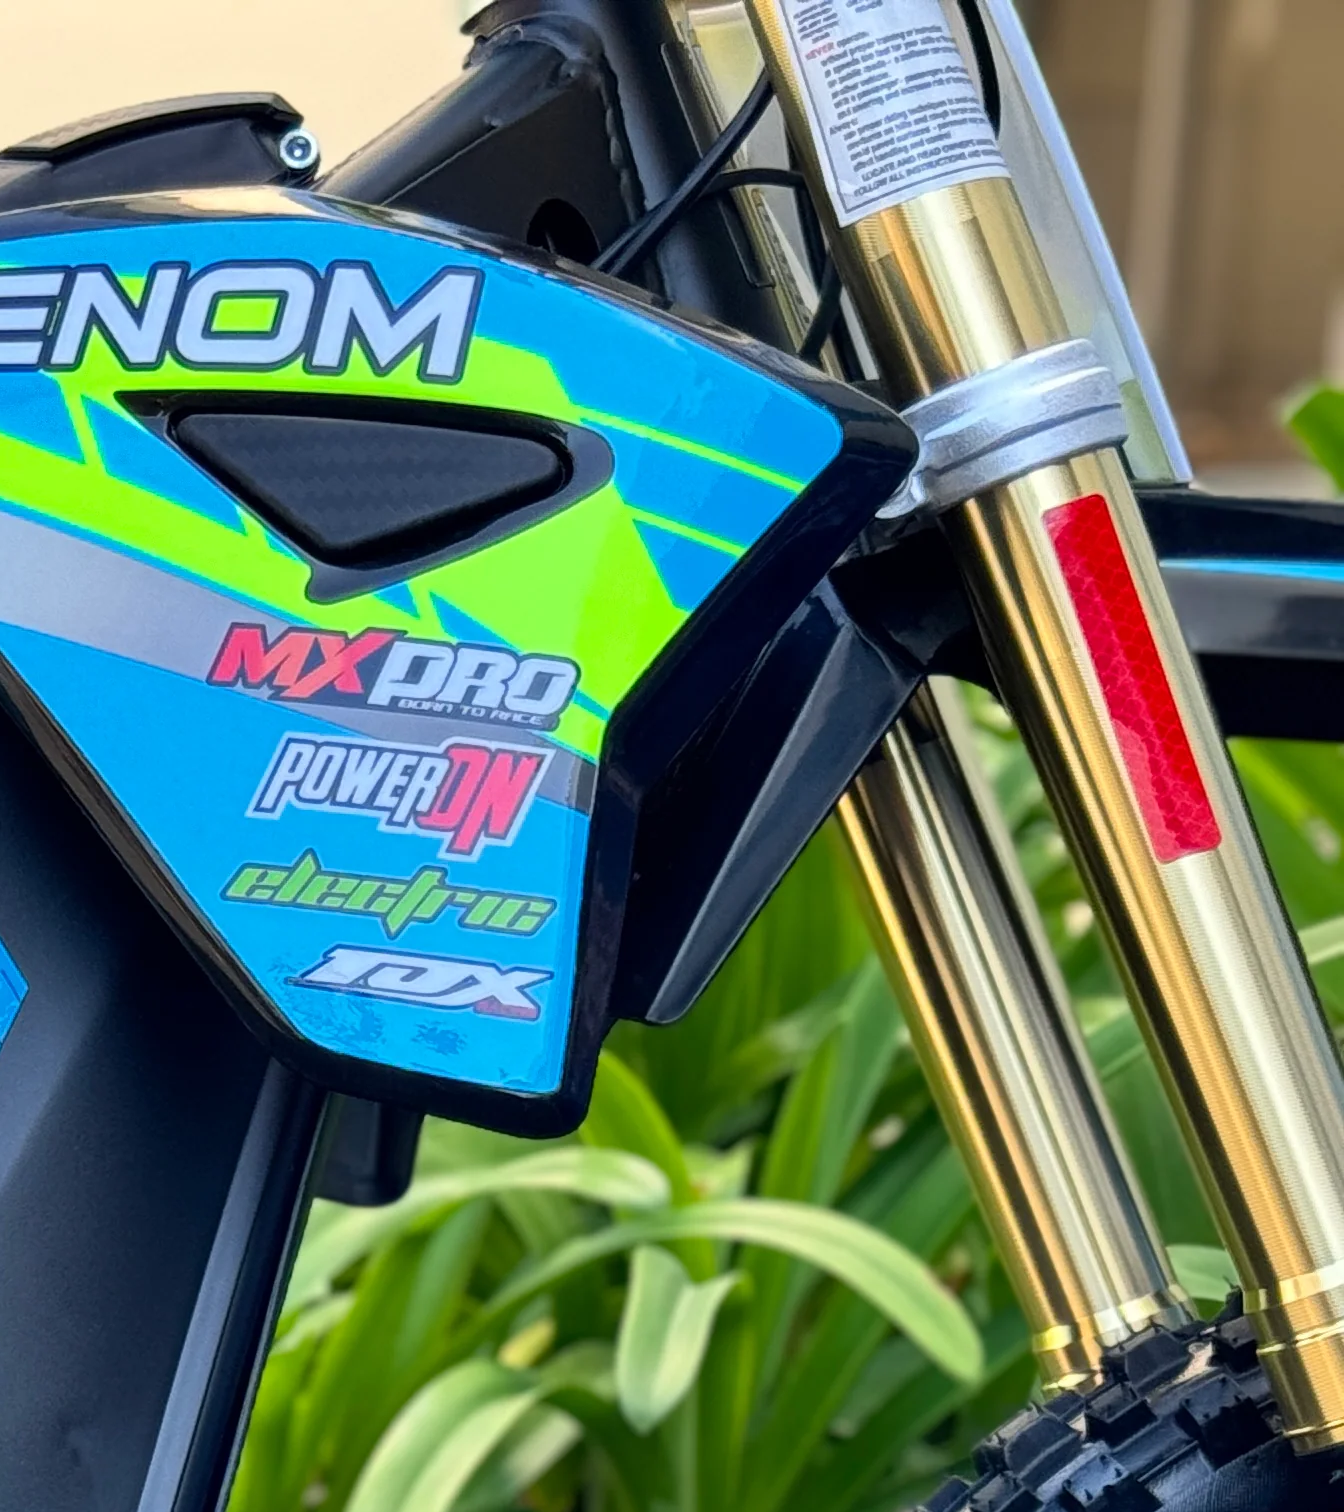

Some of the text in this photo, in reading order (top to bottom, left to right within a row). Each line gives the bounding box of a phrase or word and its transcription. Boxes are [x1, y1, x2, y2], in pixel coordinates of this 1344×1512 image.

[397, 698, 544, 726] BORN TO RACE
